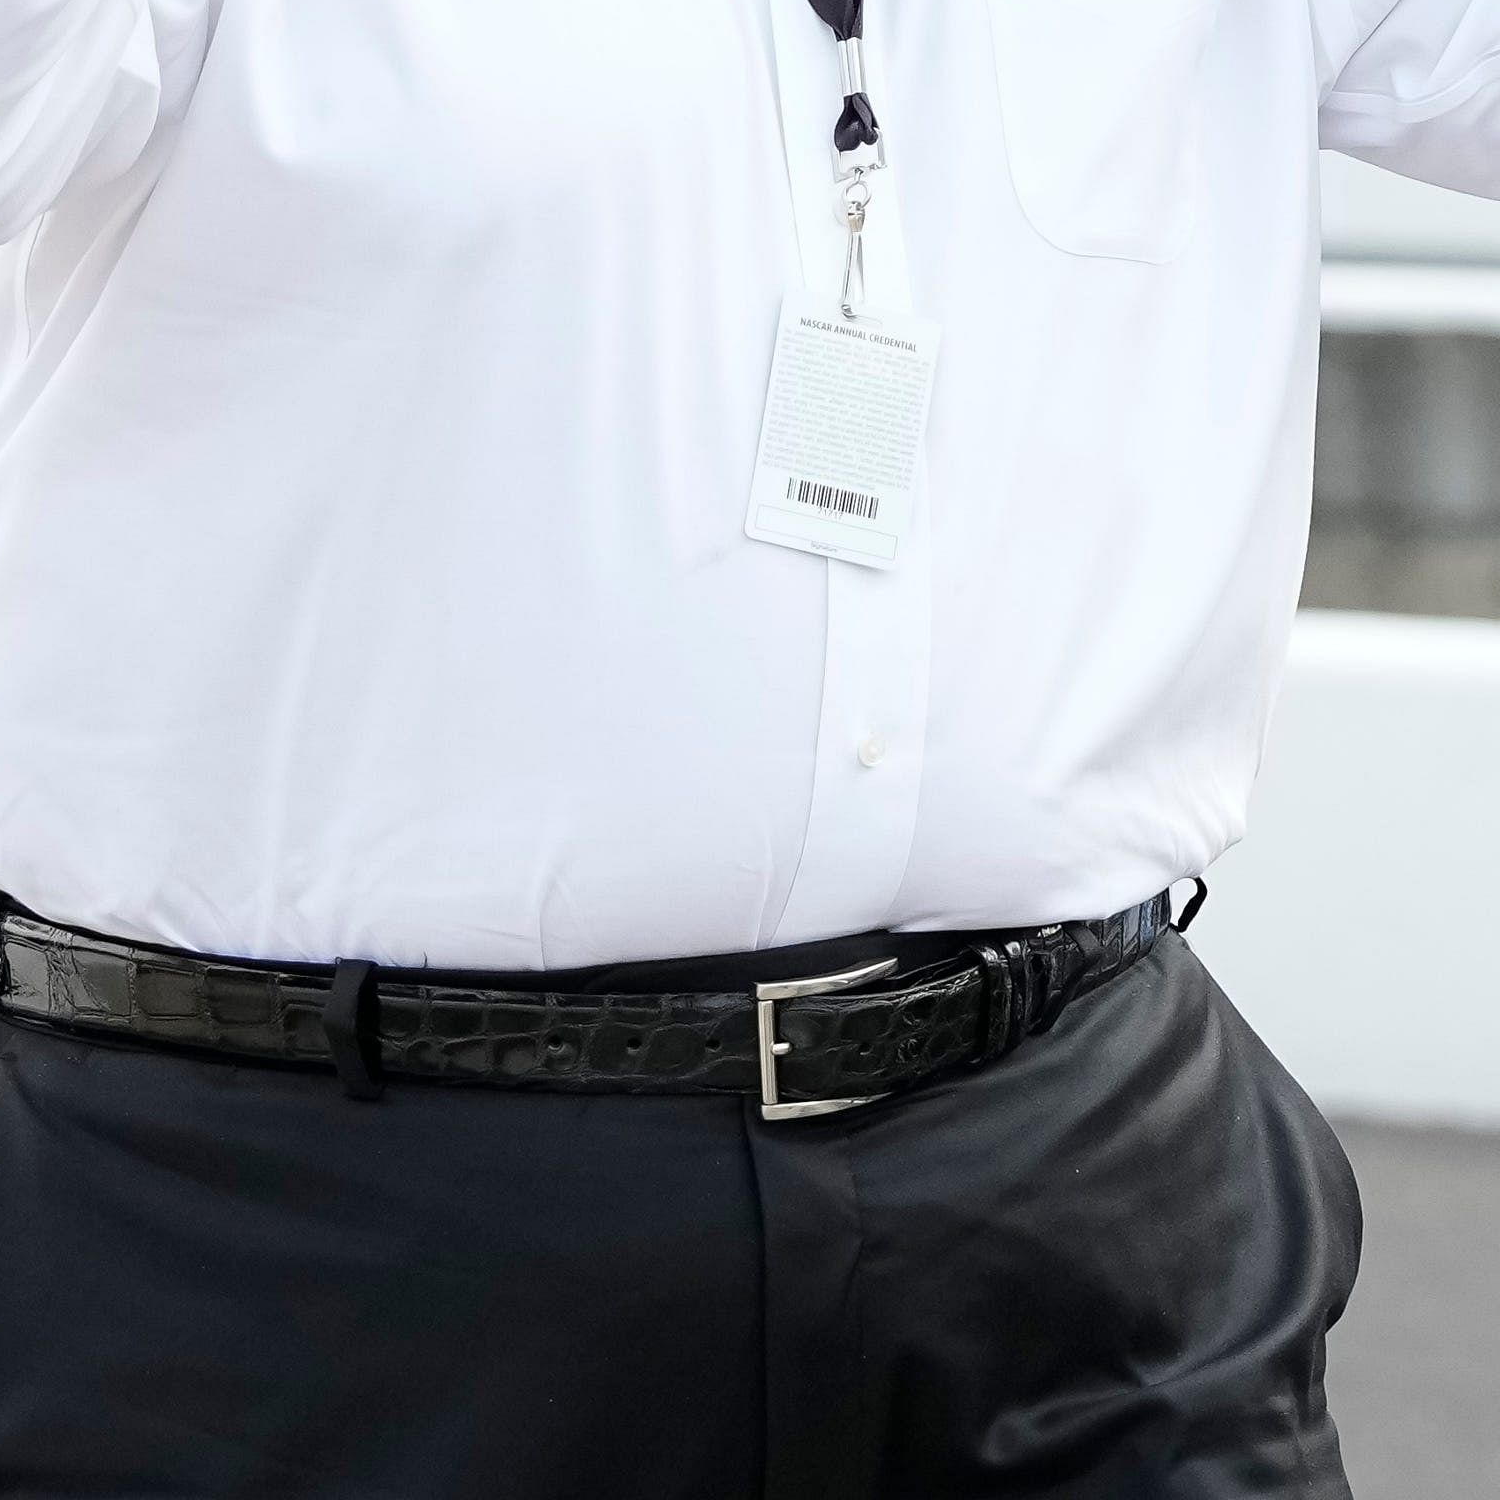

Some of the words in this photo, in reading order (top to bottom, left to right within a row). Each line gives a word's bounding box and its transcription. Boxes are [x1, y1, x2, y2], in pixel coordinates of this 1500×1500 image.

[800, 317, 832, 332] NASCAR
[834, 325, 867, 340] ANNUAL
[869, 333, 917, 353] CREDENTIAL
